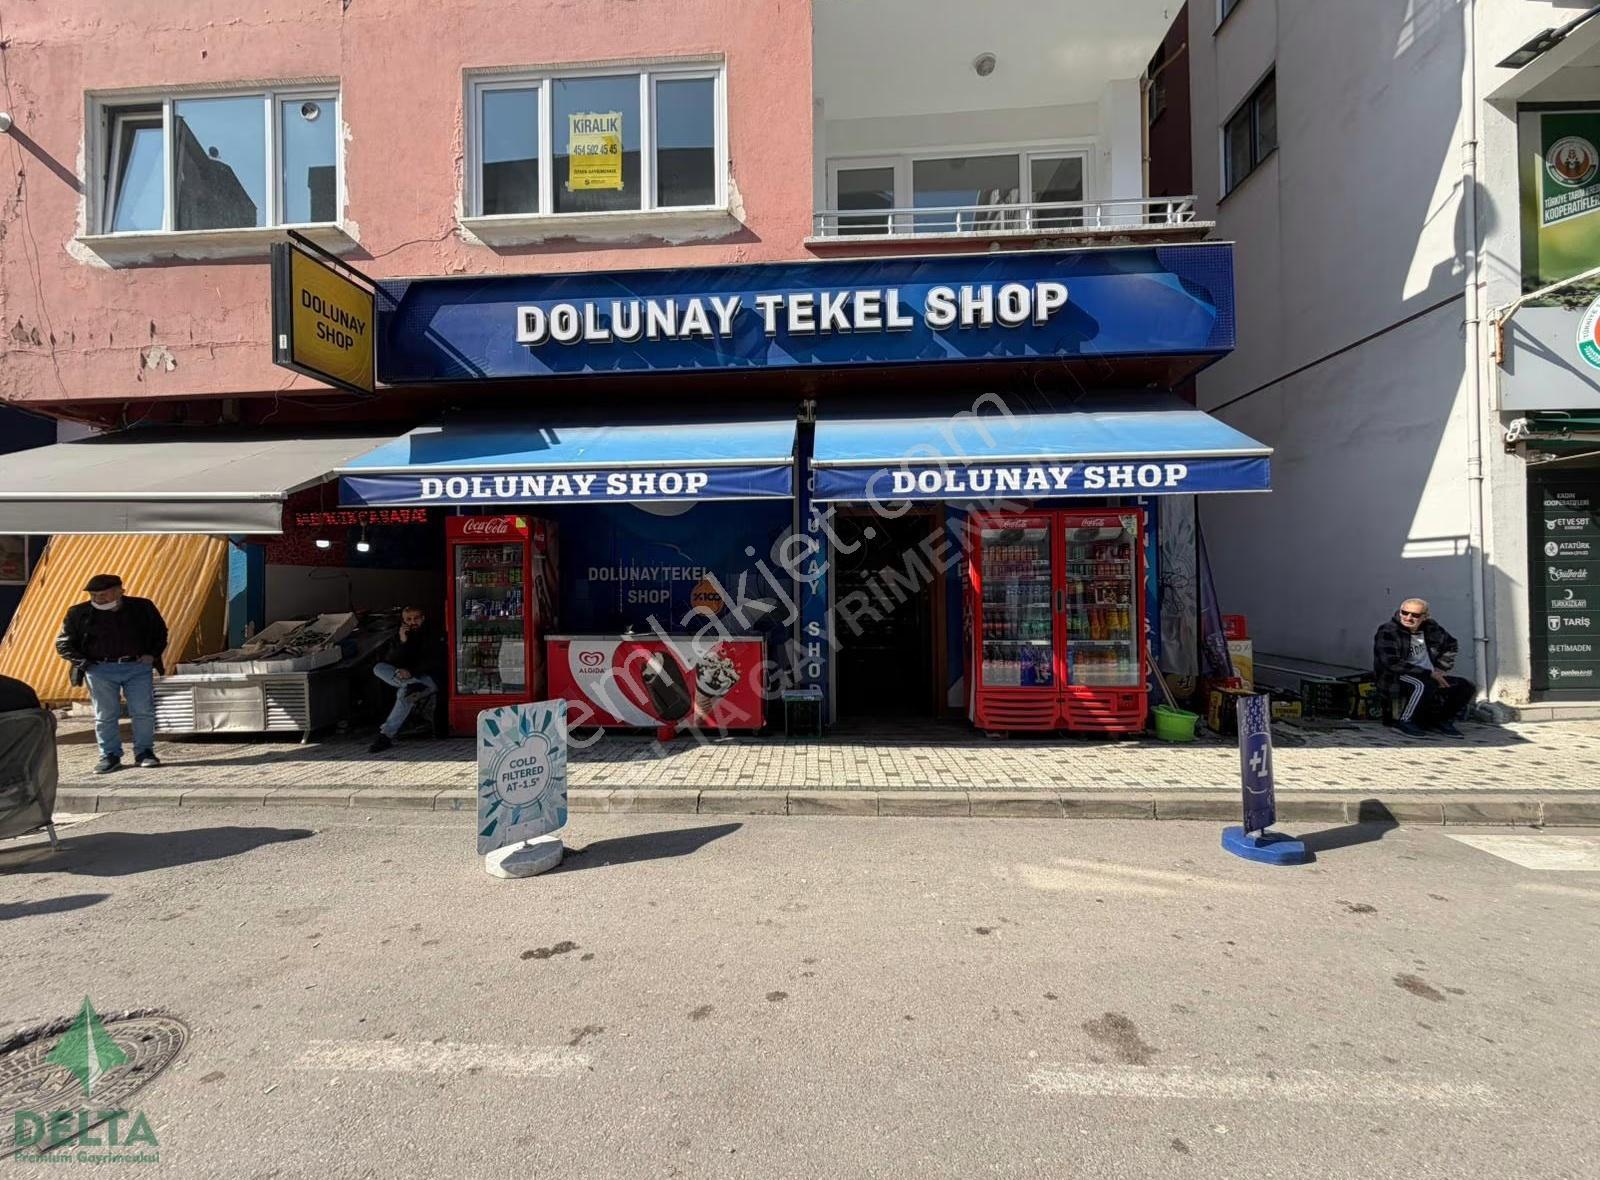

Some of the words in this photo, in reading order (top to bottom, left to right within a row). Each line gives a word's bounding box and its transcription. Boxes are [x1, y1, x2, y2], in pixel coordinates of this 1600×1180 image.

[302, 288, 366, 335] DOLUNAY
[516, 296, 742, 346] DOLUNAY
[755, 289, 914, 337] TEKEL
[925, 281, 1069, 330] SHOP
[317, 321, 354, 351] SHOP
[420, 473, 597, 499] DOLUNAY
[606, 471, 709, 495] SHOP
[892, 467, 1073, 493] DOLUNAY
[1083, 463, 1188, 489] SHOP
[588, 567, 661, 581] DOLUNAY
[628, 590, 670, 604] SHOP
[1563, 616, 1591, 627] TARİŞ
[502, 766, 544, 782] FILTERED
[509, 756, 537, 769] COLD
[1249, 744, 1268, 777] +1
